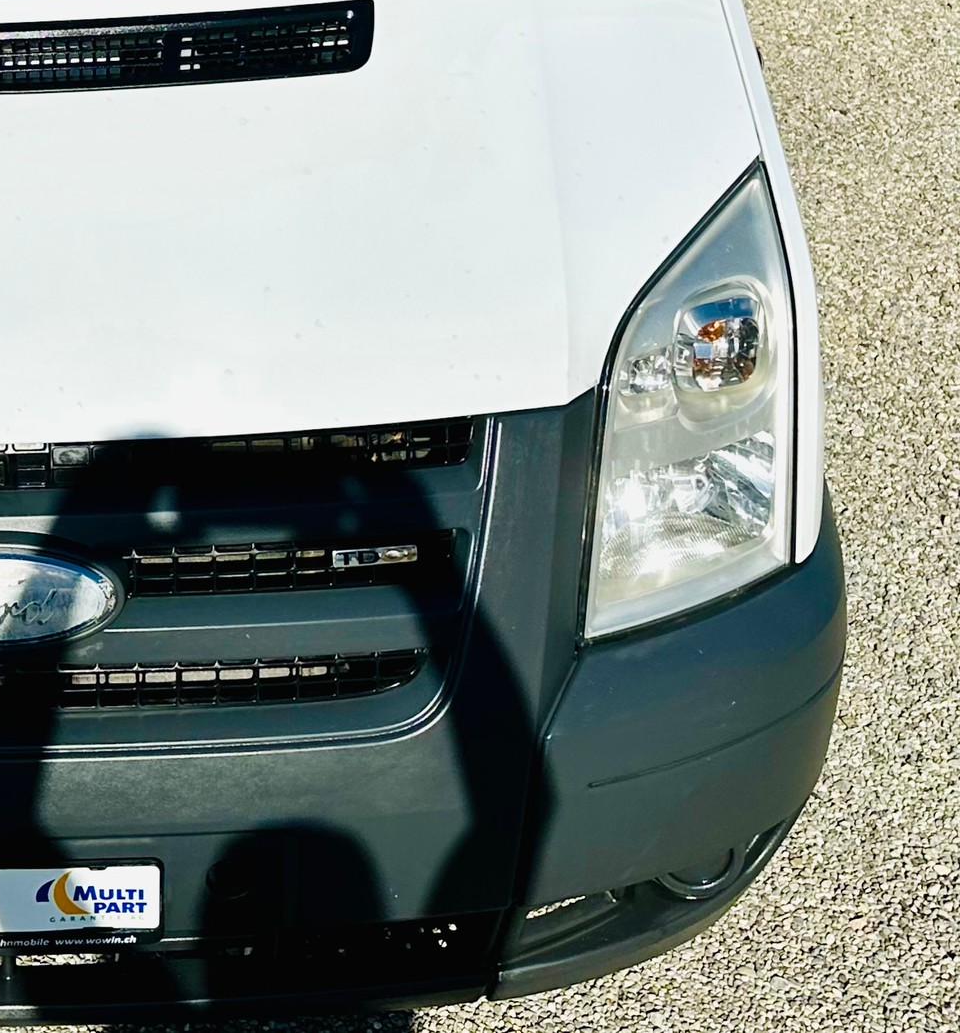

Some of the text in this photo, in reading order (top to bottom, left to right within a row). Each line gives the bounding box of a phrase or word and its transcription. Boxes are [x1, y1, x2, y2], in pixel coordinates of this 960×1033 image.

[72, 885, 145, 902] MULTI
[93, 901, 148, 915] PART
[54, 934, 138, 946] www.wowin.ch
